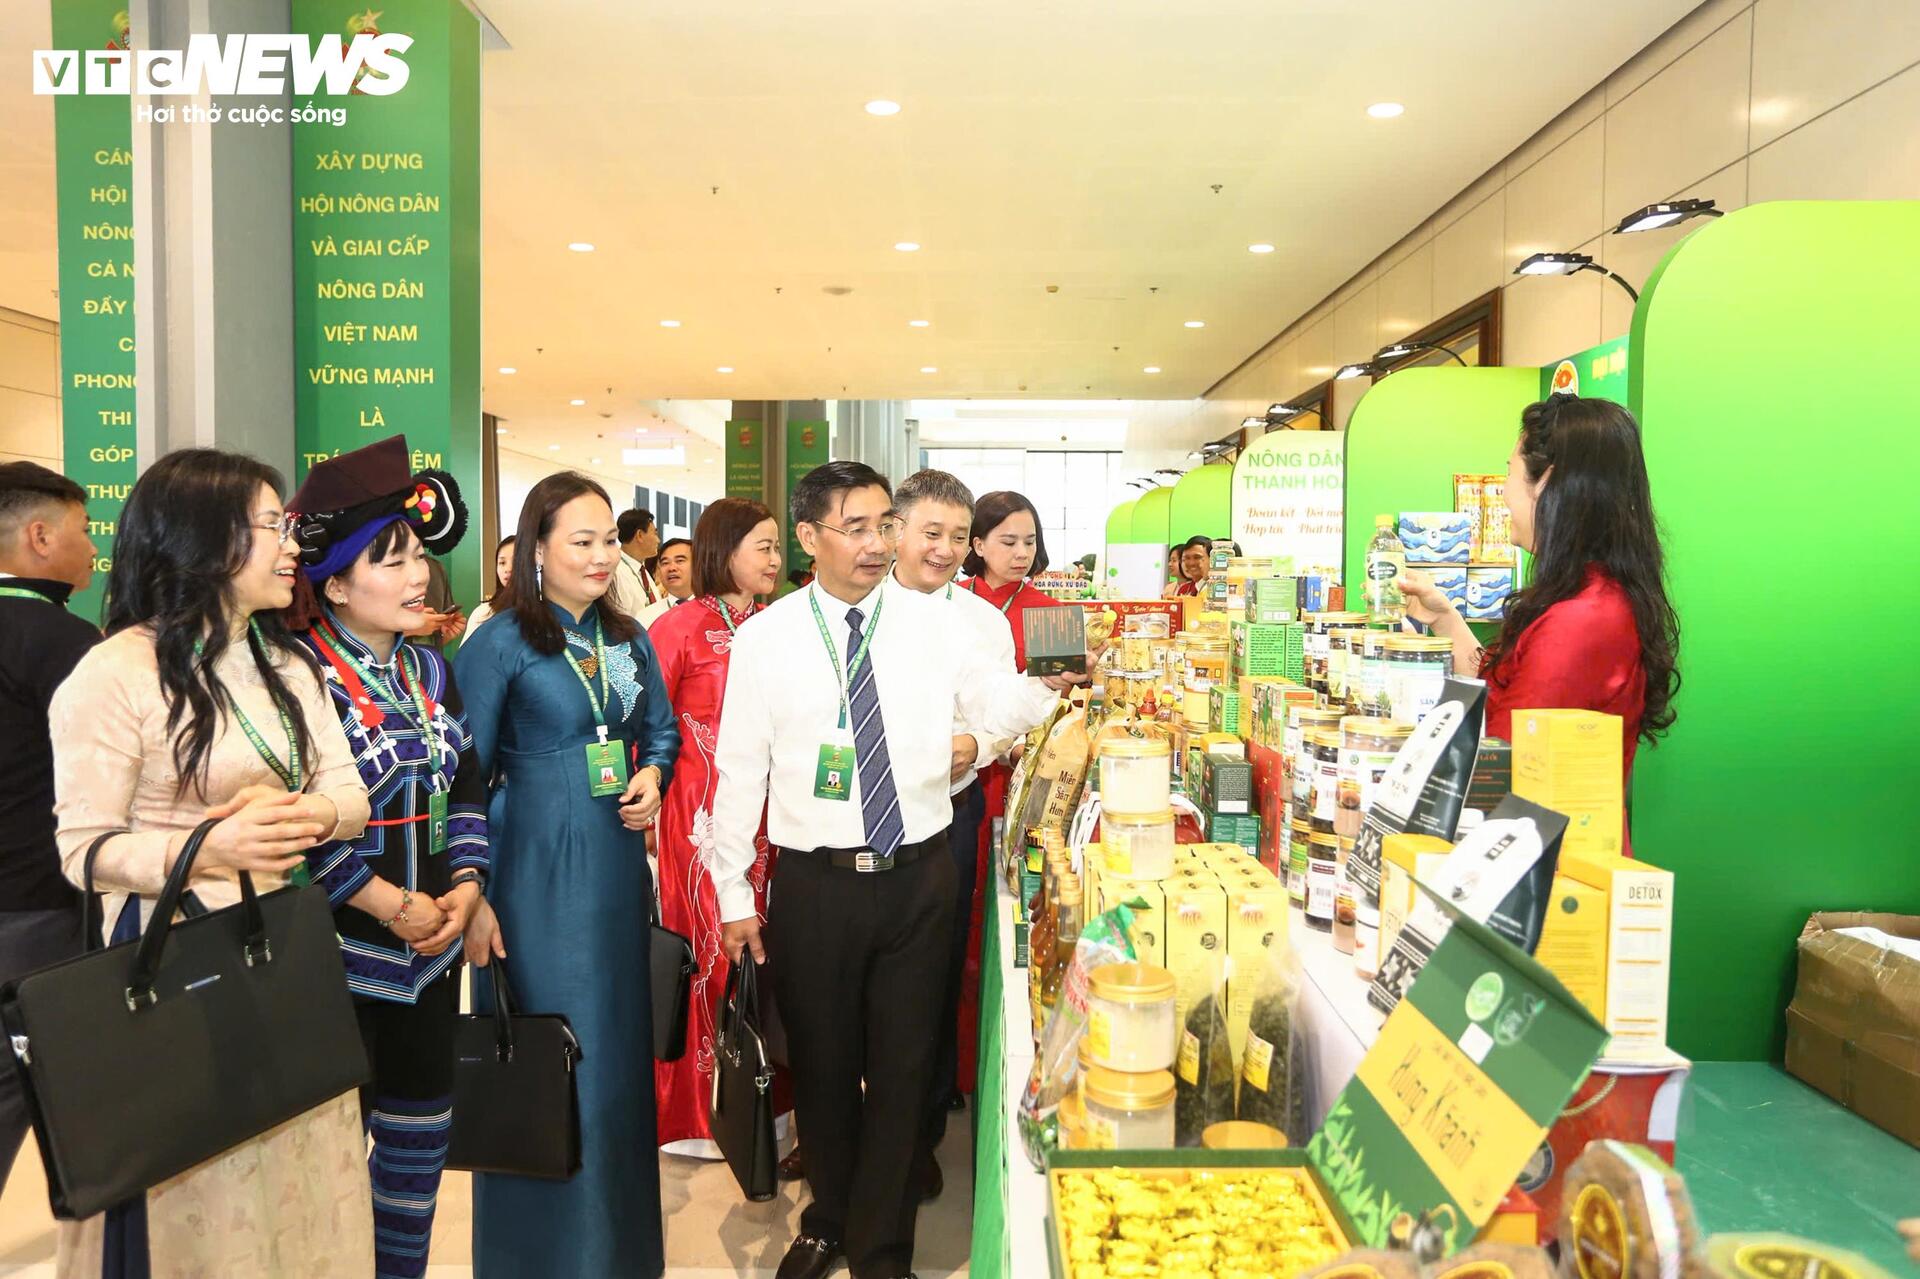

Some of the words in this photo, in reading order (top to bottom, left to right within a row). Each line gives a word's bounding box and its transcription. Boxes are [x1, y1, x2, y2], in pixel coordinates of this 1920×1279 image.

[316, 150, 355, 170] XÂY
[361, 153, 423, 174] DỰNG
[91, 185, 127, 205] HỘI
[301, 193, 334, 217] HỘI
[339, 193, 395, 213] NÔNG
[400, 192, 440, 213] DÂN
[311, 234, 338, 256] VÀ
[343, 240, 382, 256] GIAI
[388, 234, 430, 256] CẤP
[88, 259, 116, 277] CẢ
[318, 279, 376, 299] NÔNG
[382, 278, 424, 298] DÂN
[83, 295, 127, 315] ĐẨY
[324, 321, 367, 346] VIỆT
[373, 325, 418, 342] NAM
[74, 374, 137, 389] PHON
[309, 364, 368, 384] VỮNG
[374, 368, 434, 388] MẠNH
[98, 411, 132, 425] THI
[360, 406, 385, 427] LÀ
[90, 445, 134, 463] GÓP
[1248, 449, 1302, 467] NÔNG
[1243, 475, 1306, 489] THANH
[1313, 474, 1343, 489] HO
[86, 484, 133, 502] THỰ
[1629, 886, 1663, 900] DETOX
